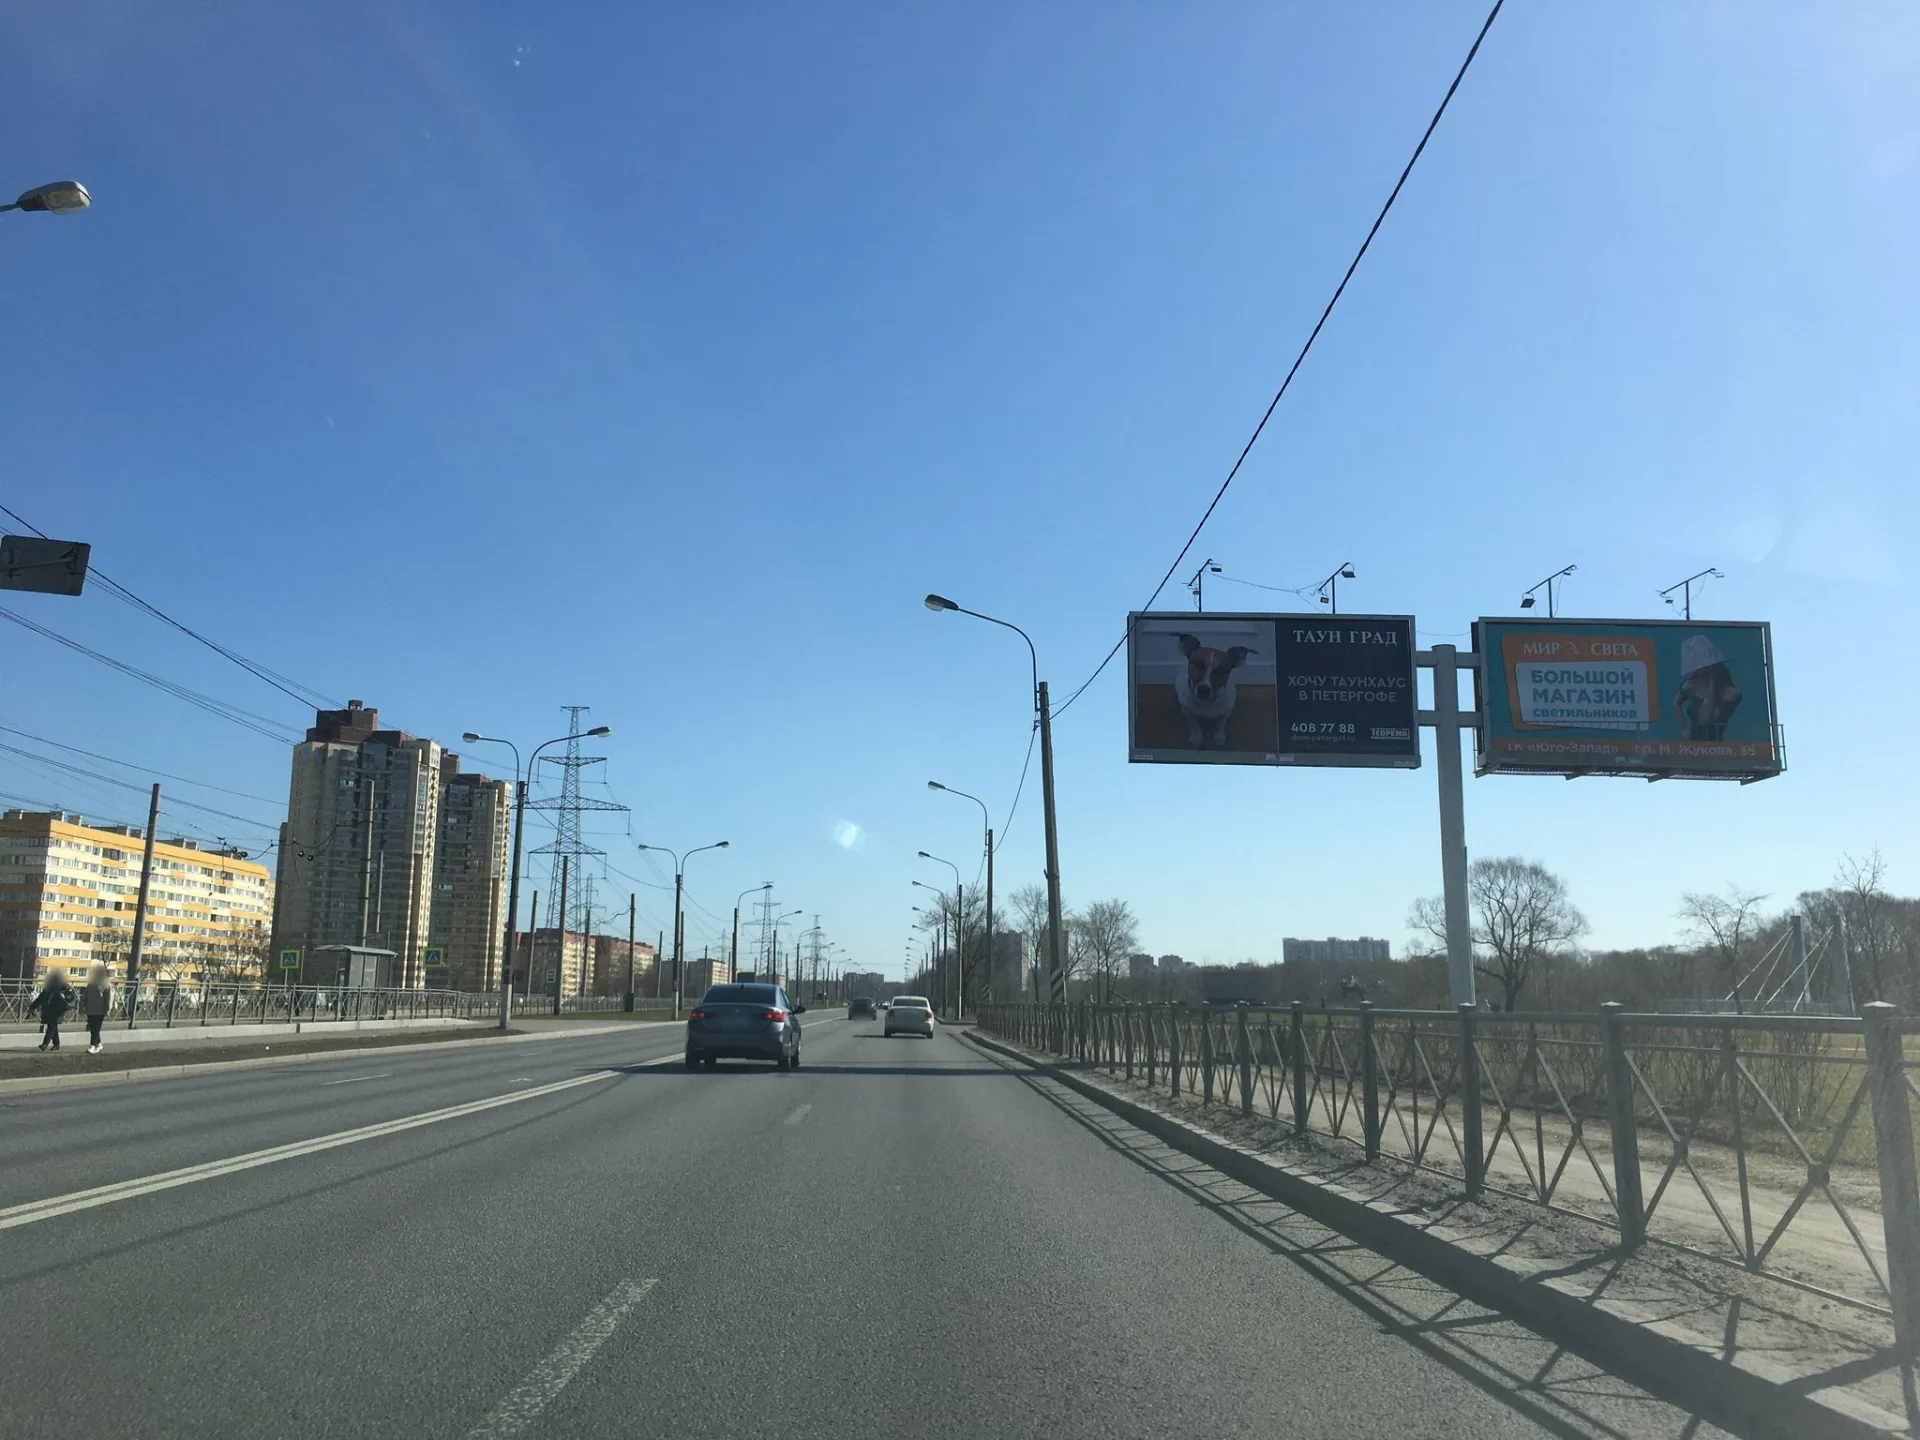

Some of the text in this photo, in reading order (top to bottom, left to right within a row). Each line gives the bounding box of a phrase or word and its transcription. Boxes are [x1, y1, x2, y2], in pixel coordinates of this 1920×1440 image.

[1293, 630, 1397, 646] ТАУН ГРАД
[1523, 642, 1638, 657] МИР СВЕТА
[1288, 675, 1406, 688] ХОЧУ ТАУНХАУС
[1531, 667, 1634, 685] БОЛЬШОЙ
[1299, 690, 1396, 702] В ПЕТЕРГОФЕ
[1532, 688, 1636, 705] МАГАЗИН
[1291, 722, 1355, 734] 408 77 88
